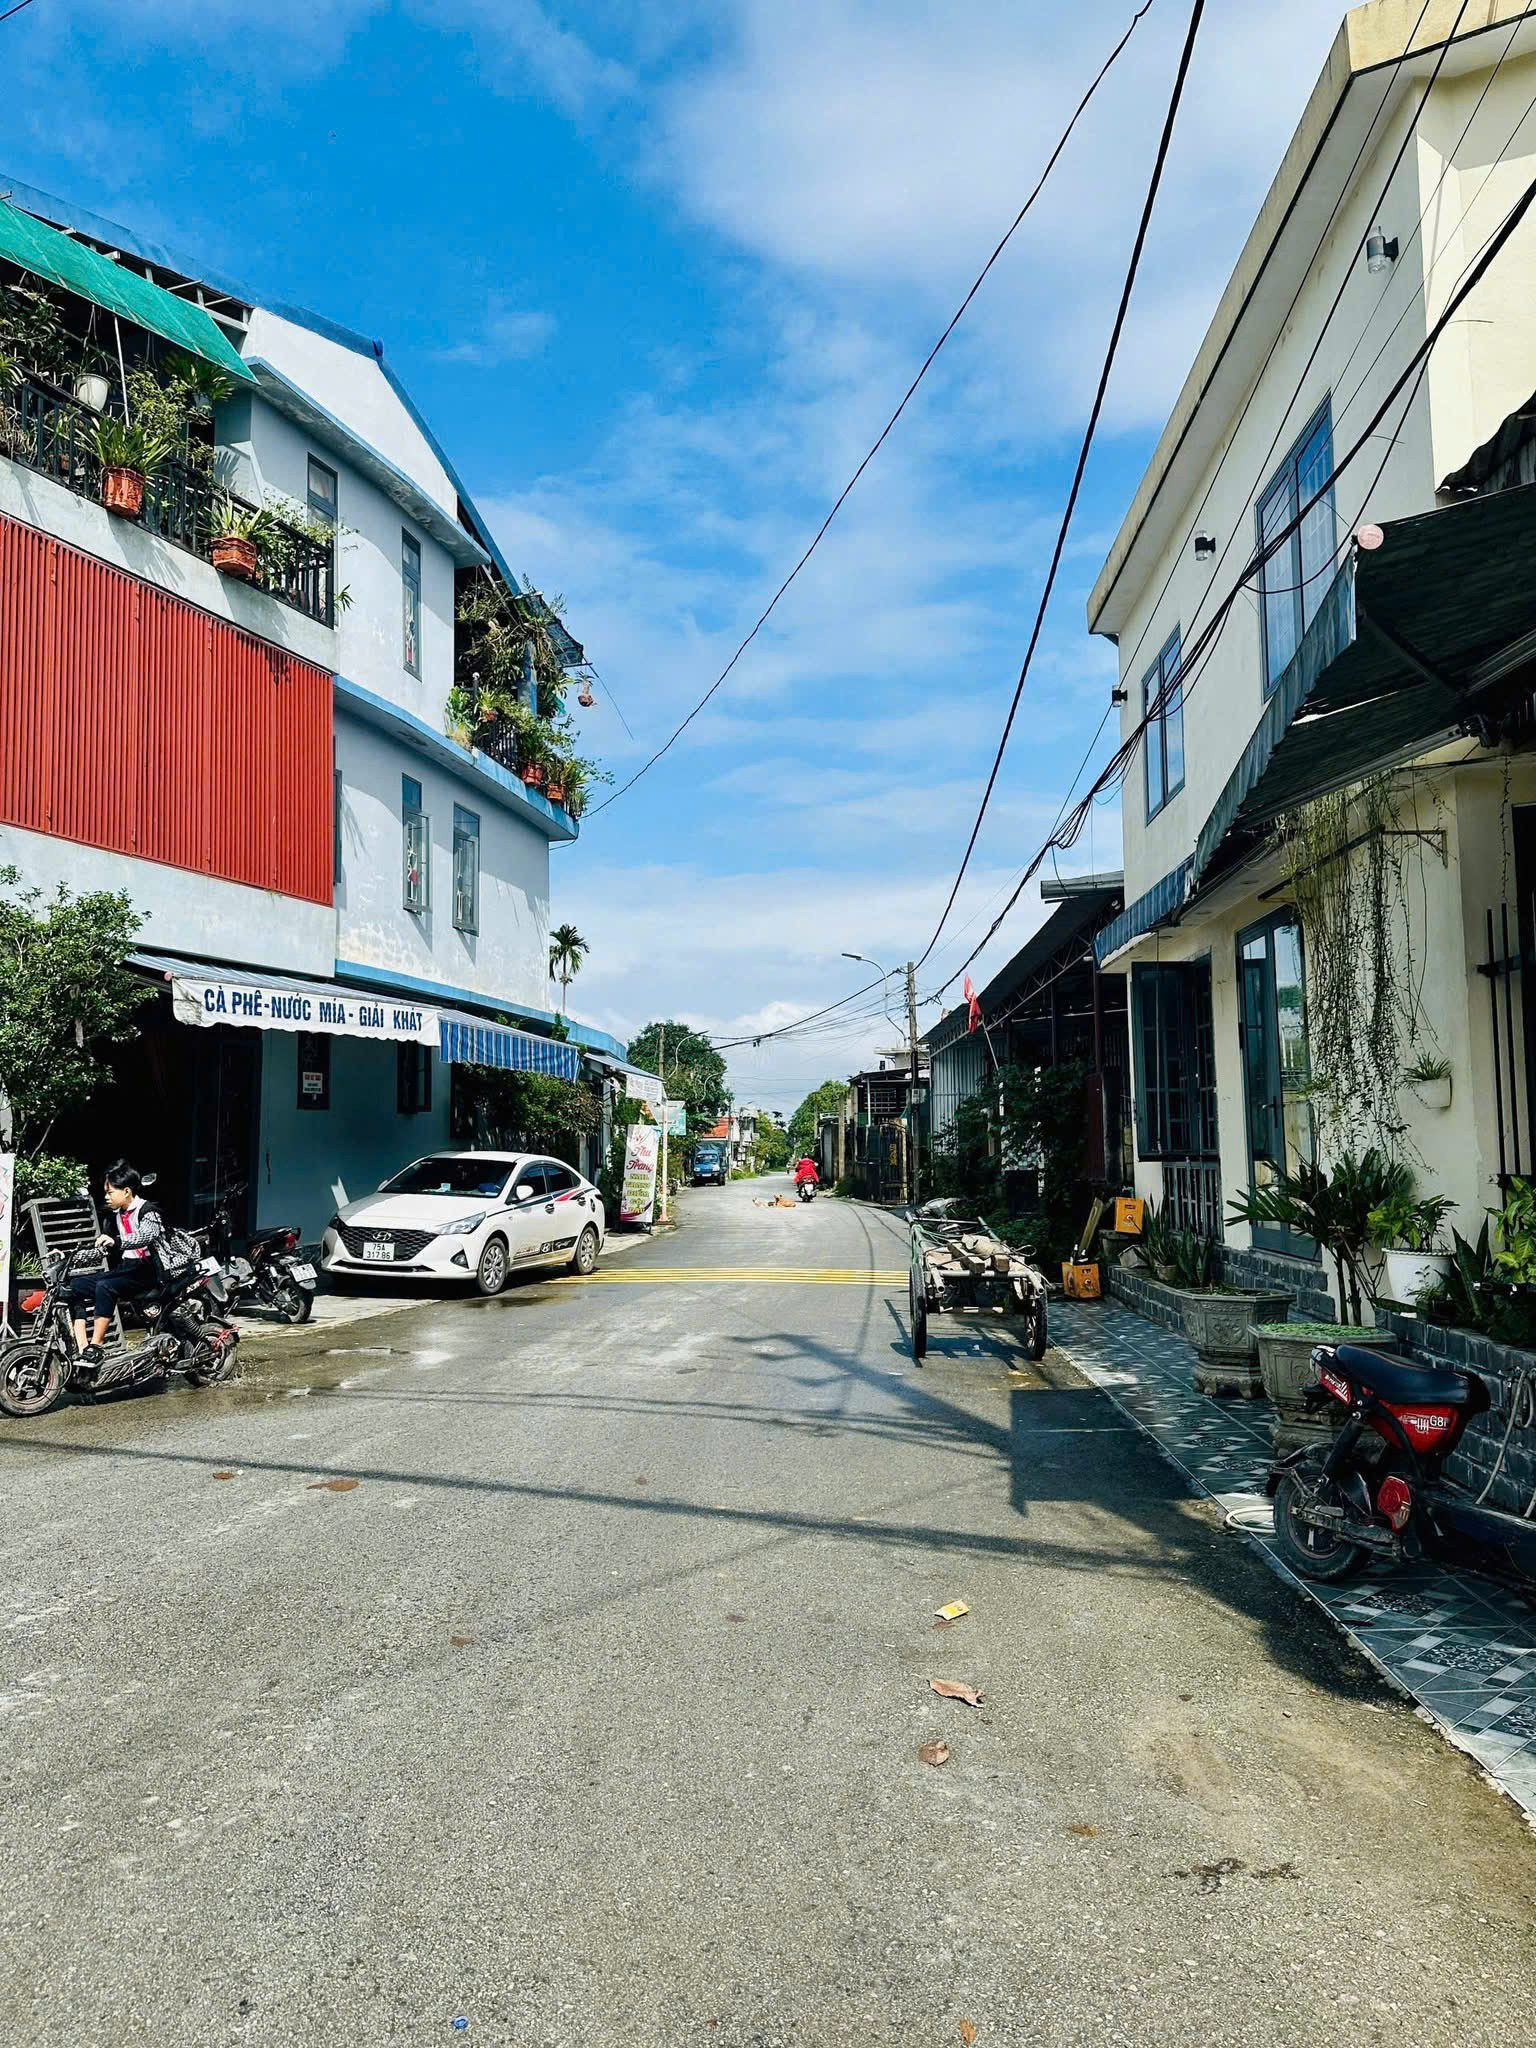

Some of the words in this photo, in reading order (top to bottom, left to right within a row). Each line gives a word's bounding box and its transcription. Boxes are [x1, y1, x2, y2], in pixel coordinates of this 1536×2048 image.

[204, 985, 227, 1013] CÀ
[319, 998, 346, 1024] MÍA
[359, 1001, 384, 1028] GIẢI
[393, 1007, 423, 1031] KHÁT
